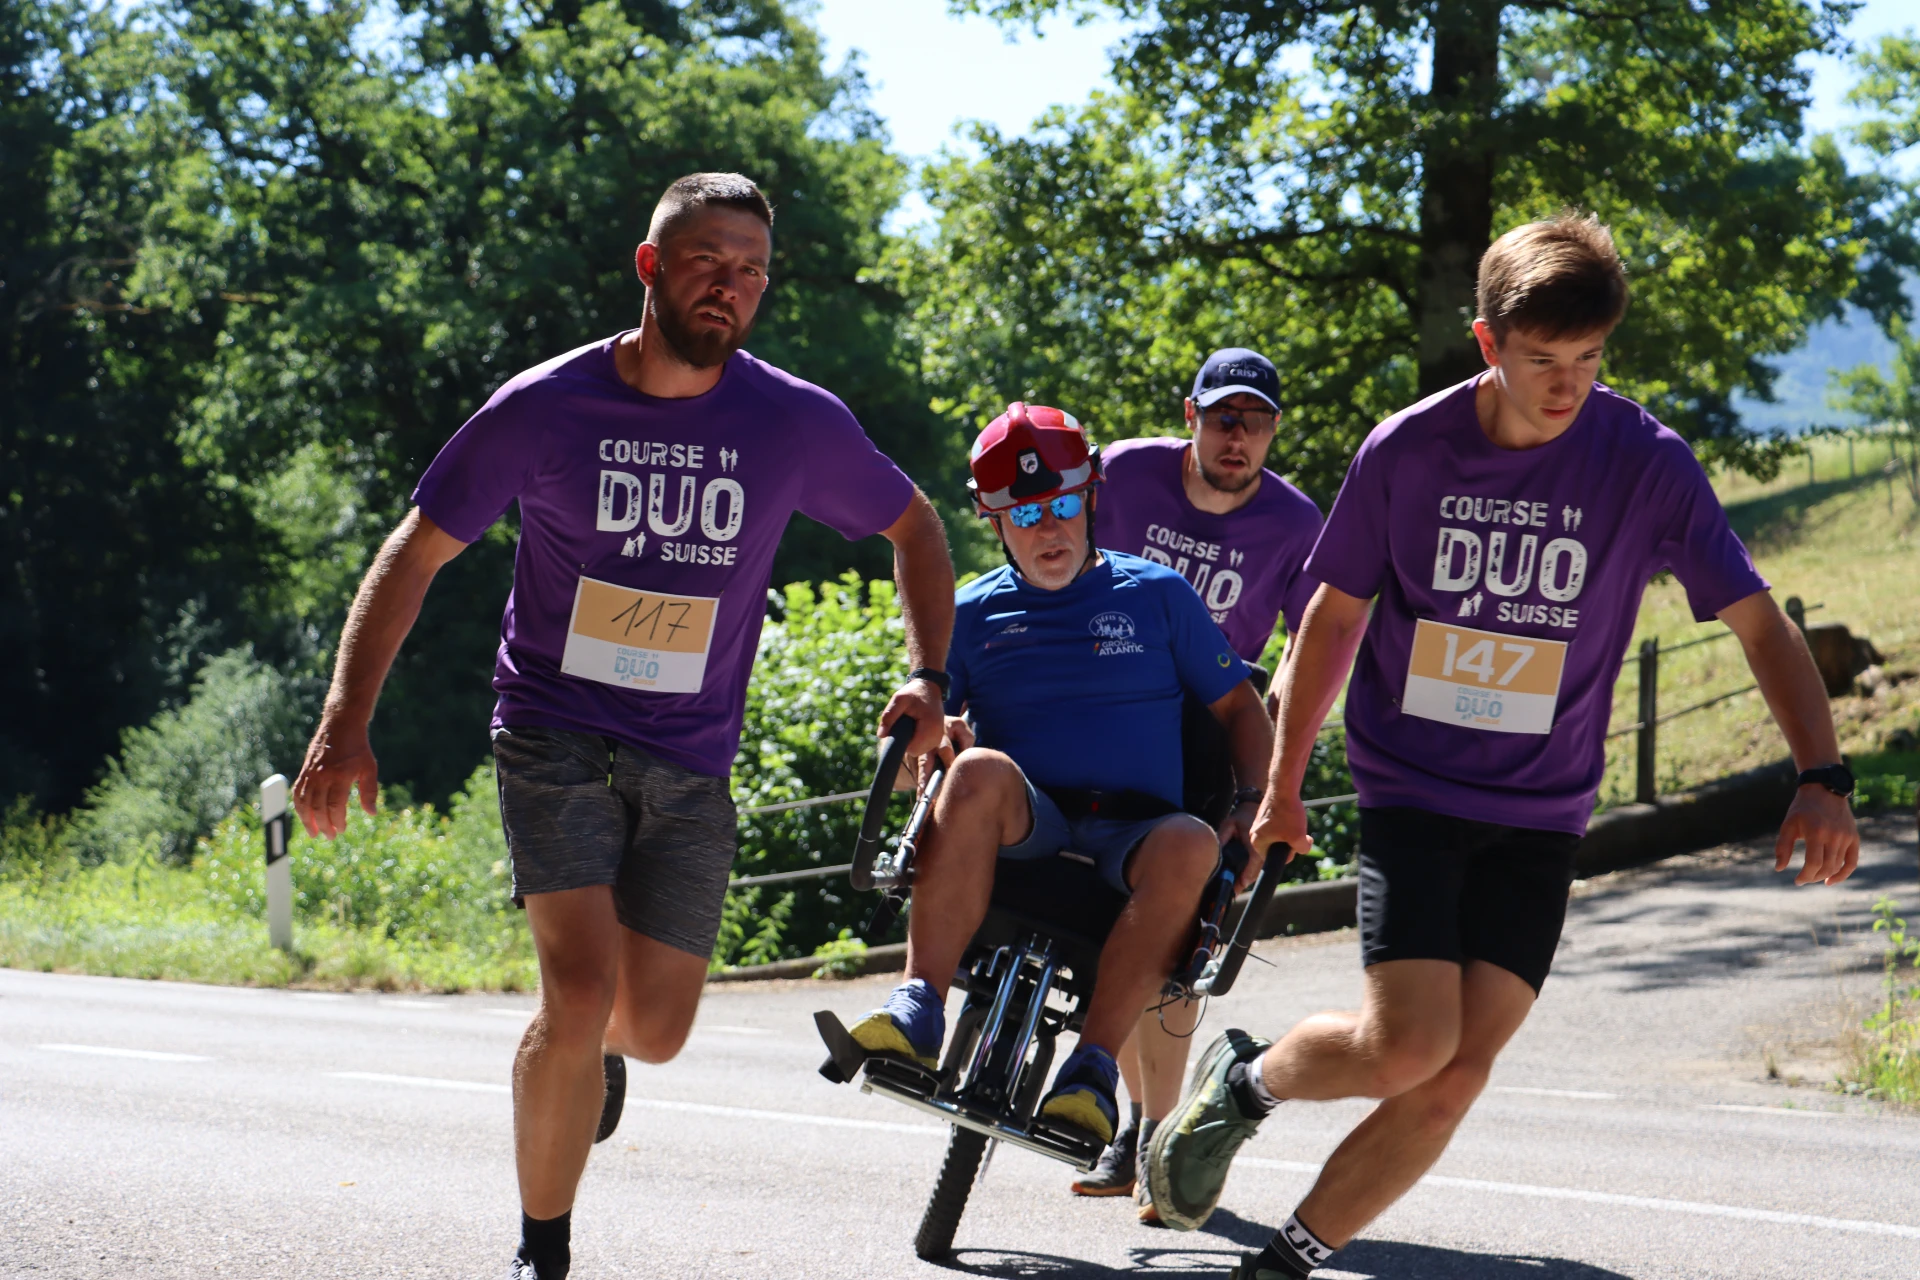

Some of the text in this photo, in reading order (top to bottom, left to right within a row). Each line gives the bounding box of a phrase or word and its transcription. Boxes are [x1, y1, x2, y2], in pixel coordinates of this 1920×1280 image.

[1229, 368, 1258, 378] CRISP
[599, 439, 704, 469] COURSE
[596, 469, 745, 542] DUO
[1439, 495, 1549, 527] COURSE
[660, 541, 738, 566] SUISSE
[1145, 523, 1222, 562] COURSE
[1432, 527, 1588, 602] DUO
[611, 597, 691, 643] 117
[1496, 601, 1580, 628] SUISSE
[617, 647, 648, 659] COURSE
[1098, 644, 1144, 656] ATLANTIC
[1442, 632, 1535, 686] 147
[614, 656, 659, 679] DUO
[1455, 695, 1503, 718] DUO
